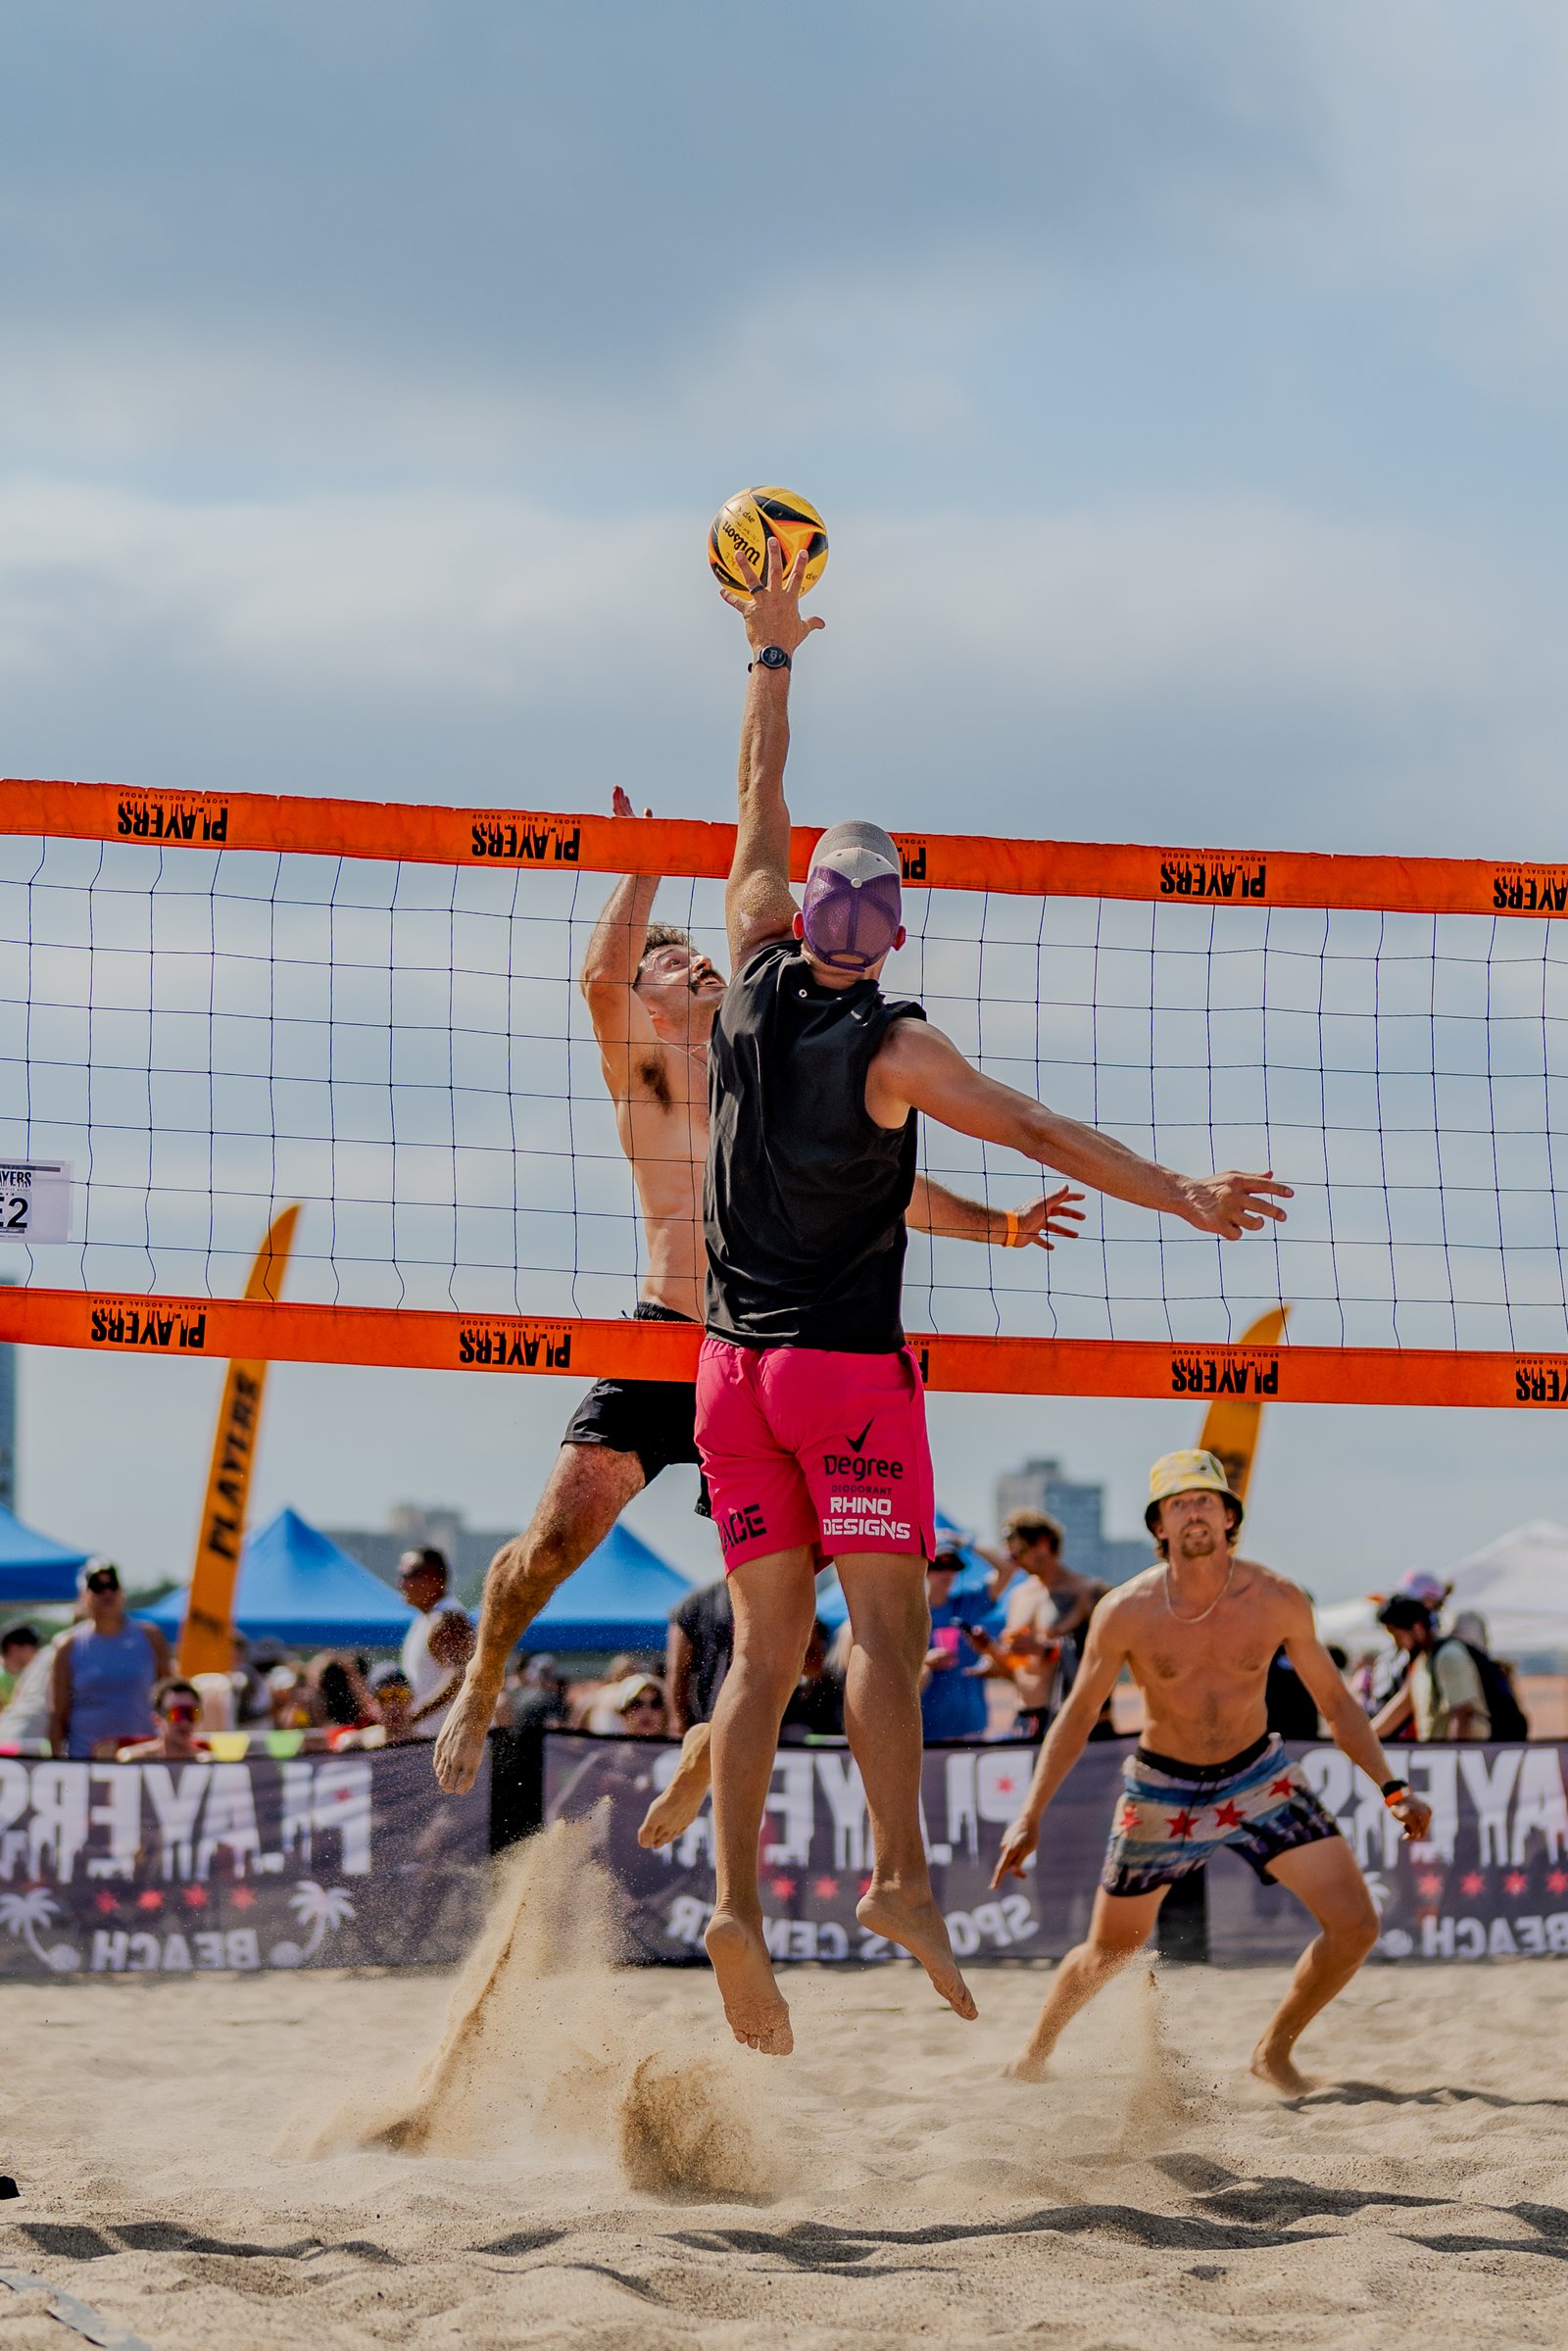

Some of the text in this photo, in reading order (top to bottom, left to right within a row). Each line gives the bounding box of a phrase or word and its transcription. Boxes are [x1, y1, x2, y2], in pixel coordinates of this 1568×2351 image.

[722, 521, 760, 566] Wilson
[118, 801, 228, 842] PLAYERS
[472, 822, 580, 861] PLAYERS
[1160, 861, 1266, 898] PLAYERS
[1494, 875, 1568, 911] AYERS
[91, 1308, 206, 1348] PLAYERS
[460, 1328, 571, 1368] PLAYERS
[1172, 1358, 1278, 1394] PLAYERS
[824, 1455, 903, 1481] Degree
[831, 1497, 891, 1515] RHINO
[832, 1484, 892, 1495] DEODORANT
[719, 1504, 767, 1554] ACE
[823, 1518, 911, 1540] DESIGNS
